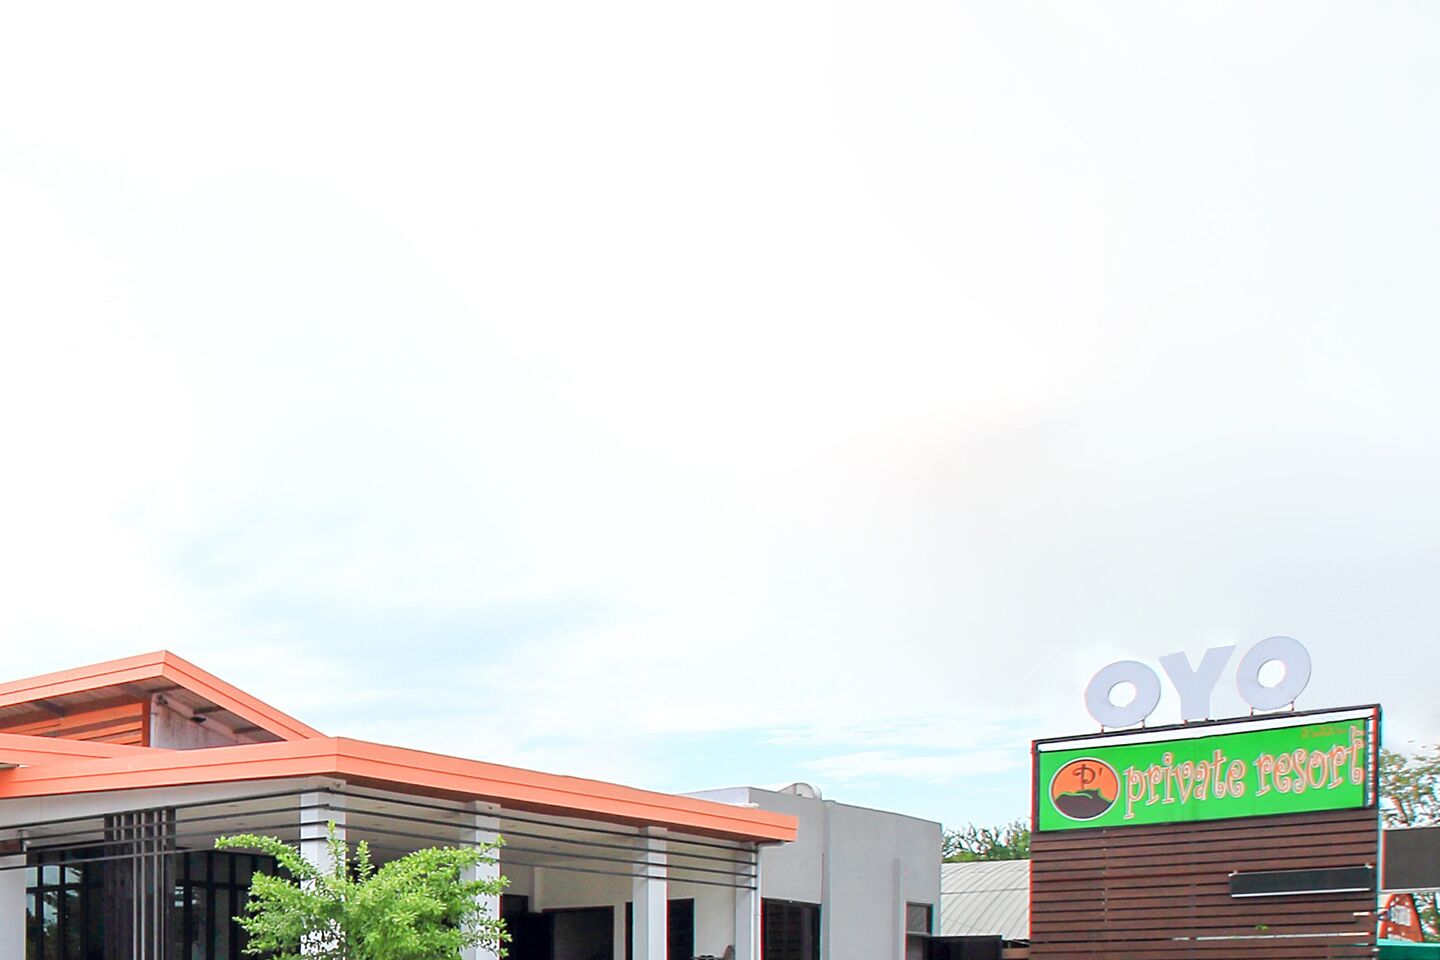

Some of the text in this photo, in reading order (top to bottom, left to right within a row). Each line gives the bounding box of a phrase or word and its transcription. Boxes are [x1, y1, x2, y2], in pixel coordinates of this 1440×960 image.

[1084, 636, 1312, 728] OYO
[1123, 725, 1365, 820] private resort
